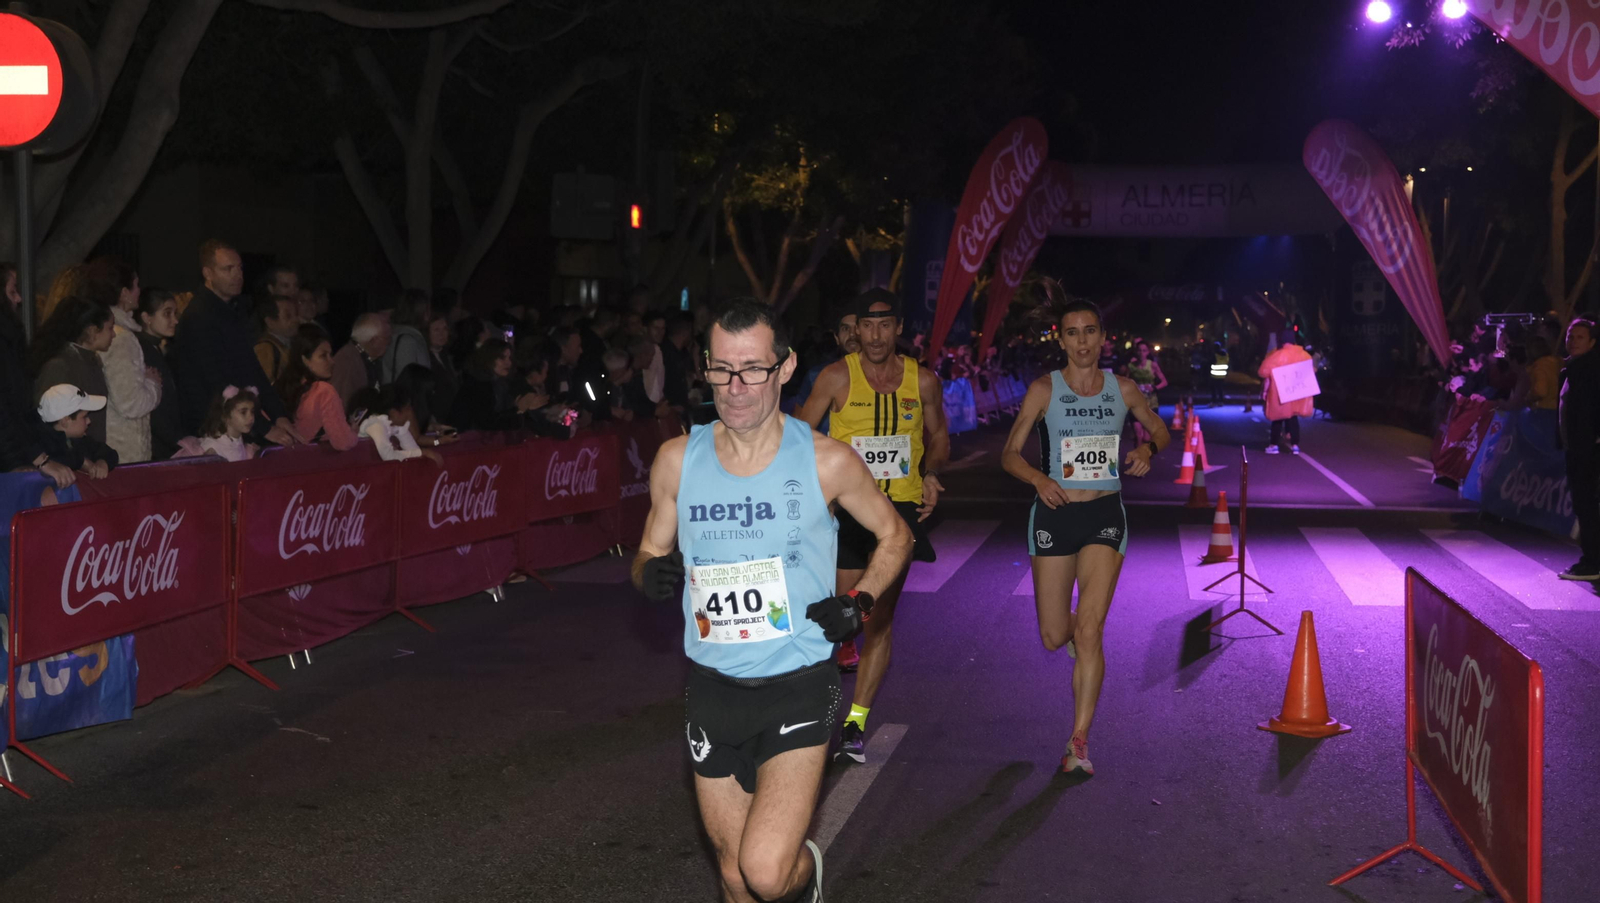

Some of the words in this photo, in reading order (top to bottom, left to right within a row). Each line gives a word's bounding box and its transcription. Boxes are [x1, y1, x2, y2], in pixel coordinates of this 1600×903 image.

[956, 125, 1040, 273] Coca-Cola
[1120, 213, 1189, 227] CIUDAD
[1065, 405, 1115, 420] nerja
[865, 450, 899, 464] 997
[1074, 450, 1107, 465] 408
[545, 447, 600, 500] Coca-Cola
[428, 464, 501, 529] Coca-Cola
[278, 483, 371, 560] Coca-Cola
[689, 496, 776, 527] nerja
[700, 529, 764, 541] ATLETISMO
[61, 508, 186, 615] Coca-Cola
[712, 567, 730, 577] SAN
[730, 561, 777, 575] SILVESTRE
[729, 575, 741, 585] DE
[706, 588, 763, 616] 410
[1424, 623, 1496, 809] Coca-Cola
